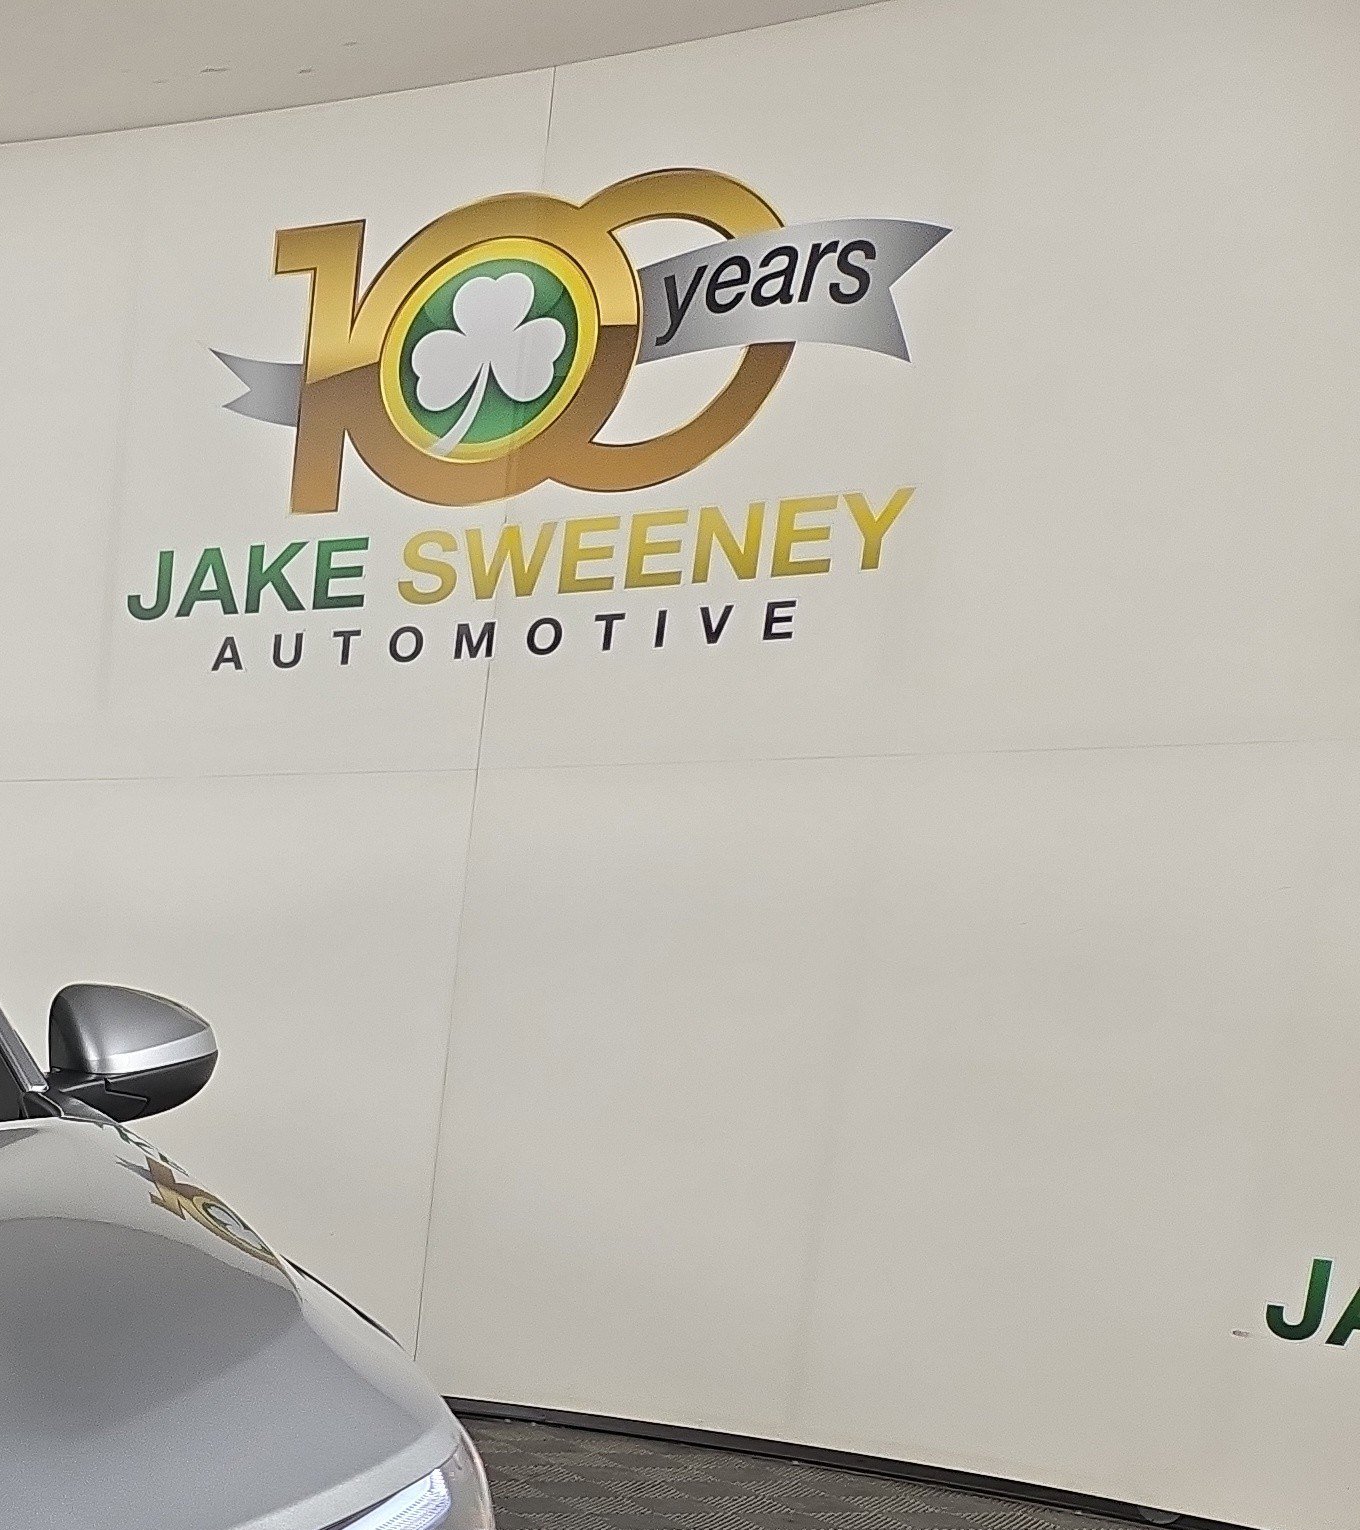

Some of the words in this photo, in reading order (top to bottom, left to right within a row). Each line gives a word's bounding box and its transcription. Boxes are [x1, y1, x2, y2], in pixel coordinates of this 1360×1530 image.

[275, 168, 796, 514] 100
[655, 237, 877, 347] years
[127, 536, 370, 621] JAKE
[398, 487, 916, 605] SWEENEY
[211, 600, 798, 672] AUTOMOTIVE
